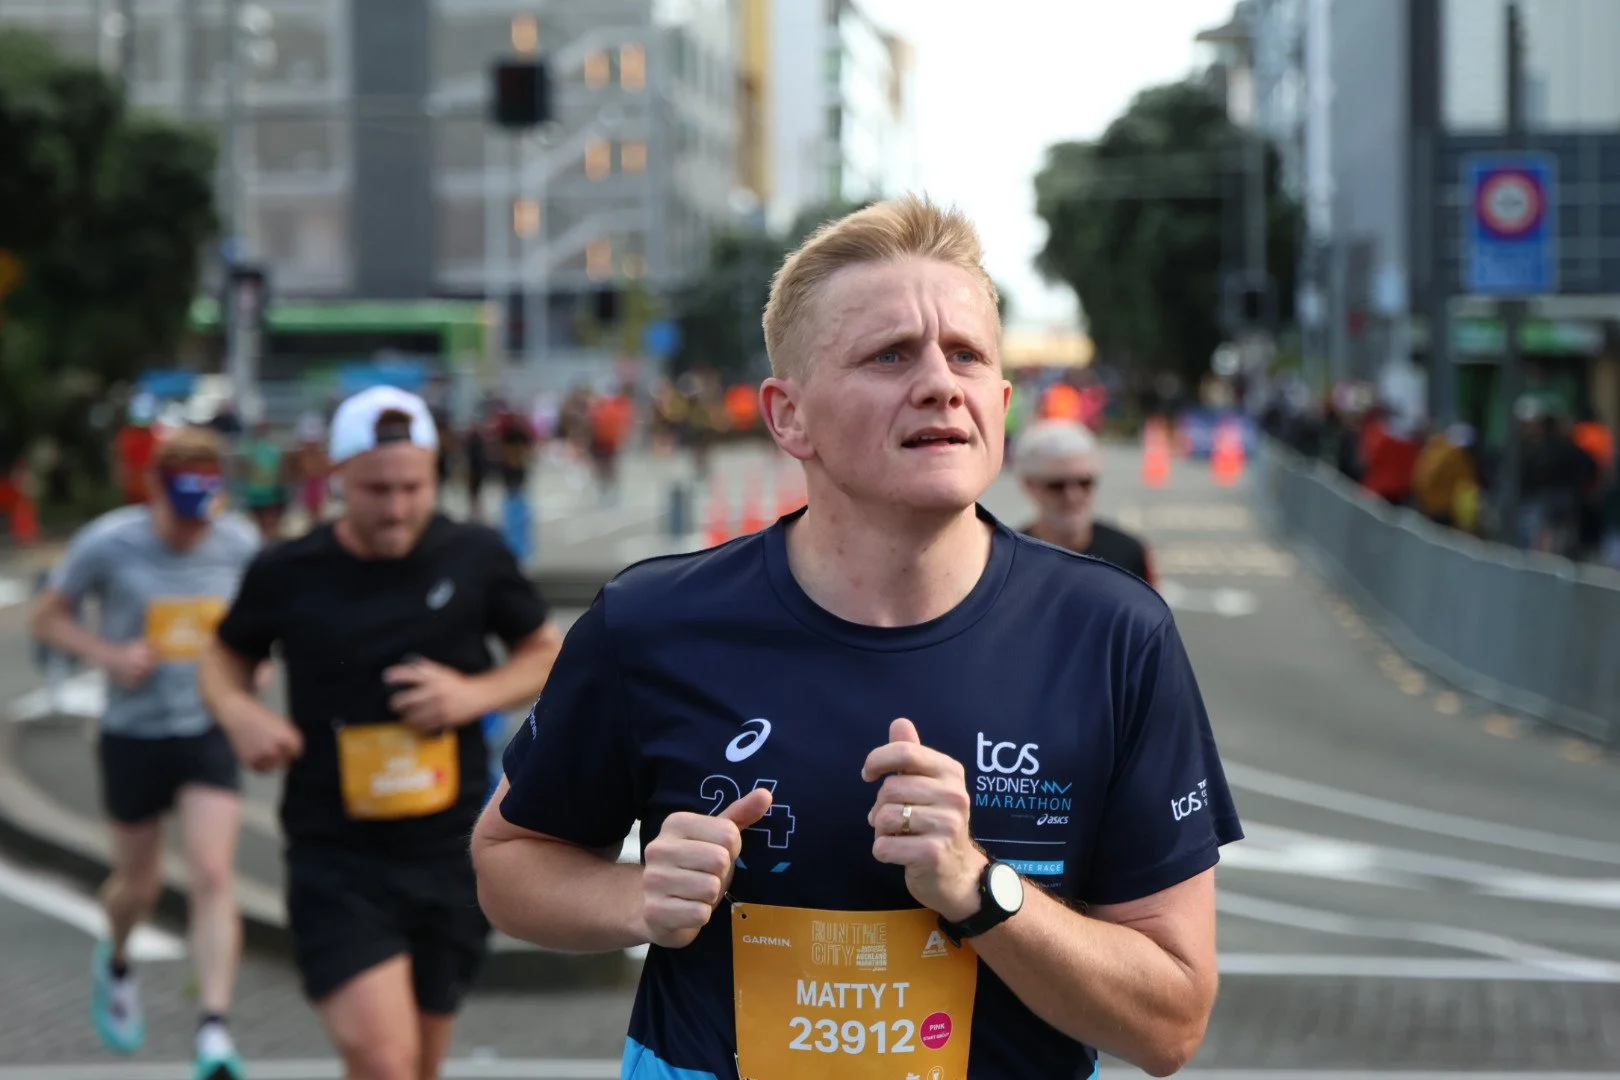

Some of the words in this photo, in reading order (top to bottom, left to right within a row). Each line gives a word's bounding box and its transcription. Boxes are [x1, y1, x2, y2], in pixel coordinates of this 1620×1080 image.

[977, 732, 1040, 775] tcs
[976, 776, 1040, 794] SYDNEY
[975, 794, 1072, 811] MARATHON
[1171, 791, 1202, 821] tcs
[1037, 863, 1062, 873] RACE
[742, 934, 791, 948] GARMIN
[812, 920, 848, 944] RUN
[848, 922, 887, 945] THE
[811, 942, 855, 967] CITY
[797, 979, 886, 1009] MATTY
[893, 982, 910, 1008] T
[789, 1016, 915, 1054] 23912
[930, 1023, 945, 1031] PINK
